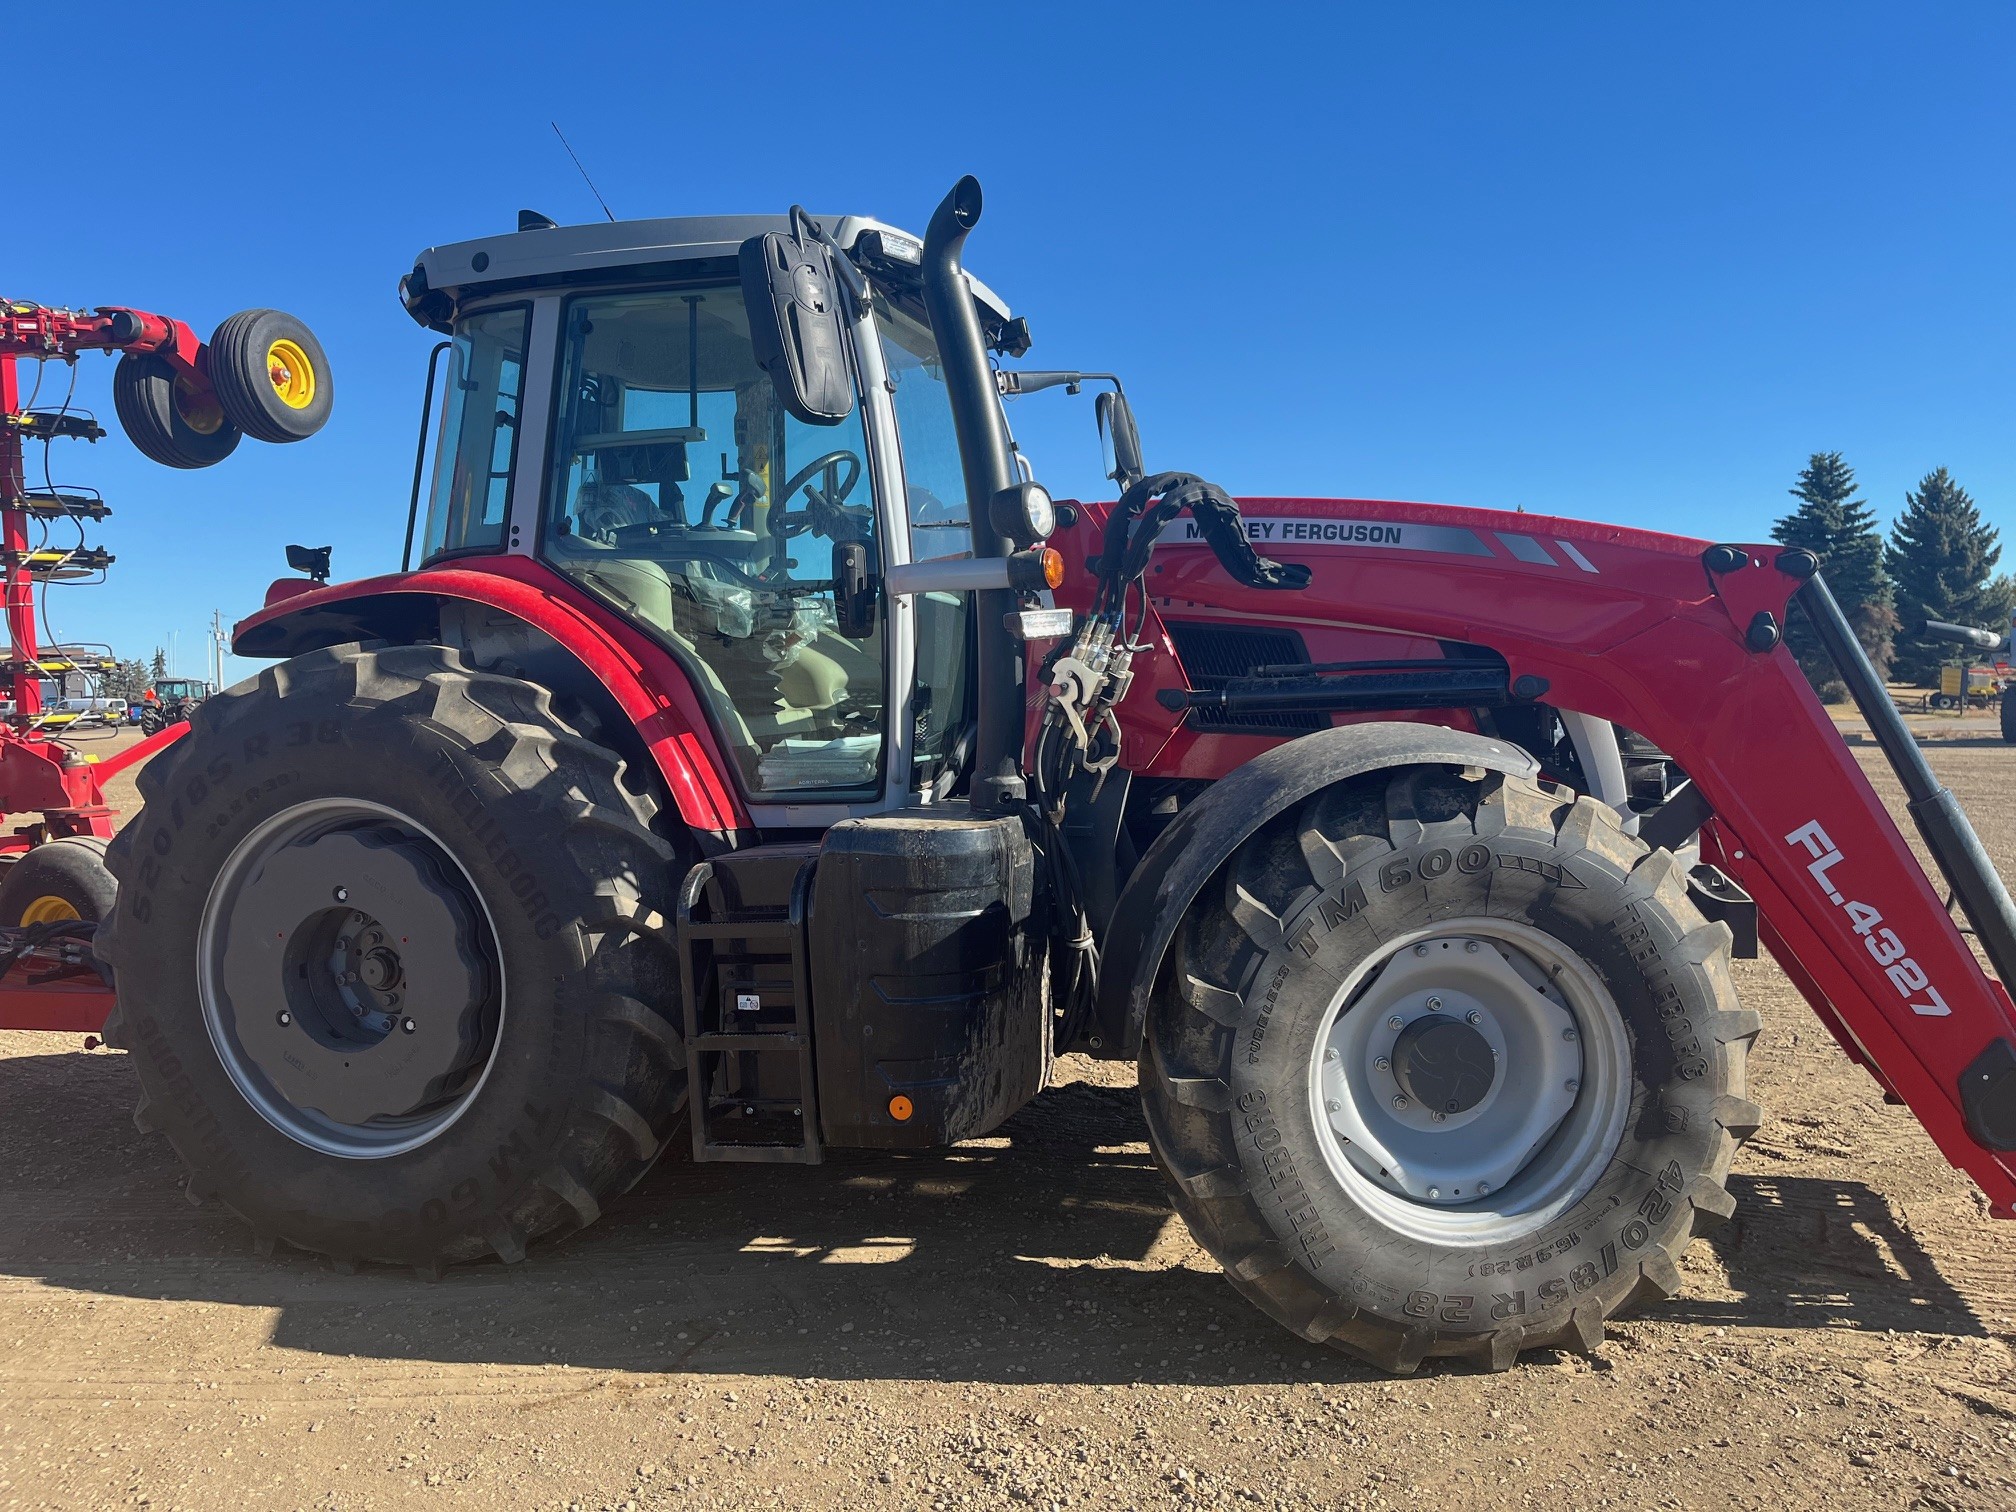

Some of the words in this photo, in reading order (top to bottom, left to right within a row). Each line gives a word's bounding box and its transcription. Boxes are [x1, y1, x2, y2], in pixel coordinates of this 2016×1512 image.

[1186, 523, 1275, 539] MEY
[1282, 523, 1401, 544] FERGUSON
[242, 730, 272, 765] R
[1284, 878, 1370, 959] TM
[1378, 843, 1492, 894] 600
[1609, 903, 1709, 1081] TRELLEBORG
[1248, 964, 1291, 1065] TUBELESS
[1237, 1088, 1337, 1269] TRELLEBORG
[1536, 1230, 1583, 1265] 16.9
[1537, 1159, 1684, 1303] 420/85
[1515, 1252, 1534, 1271] R
[1401, 1289, 1476, 1323] 28
[1490, 1289, 1527, 1321] R
